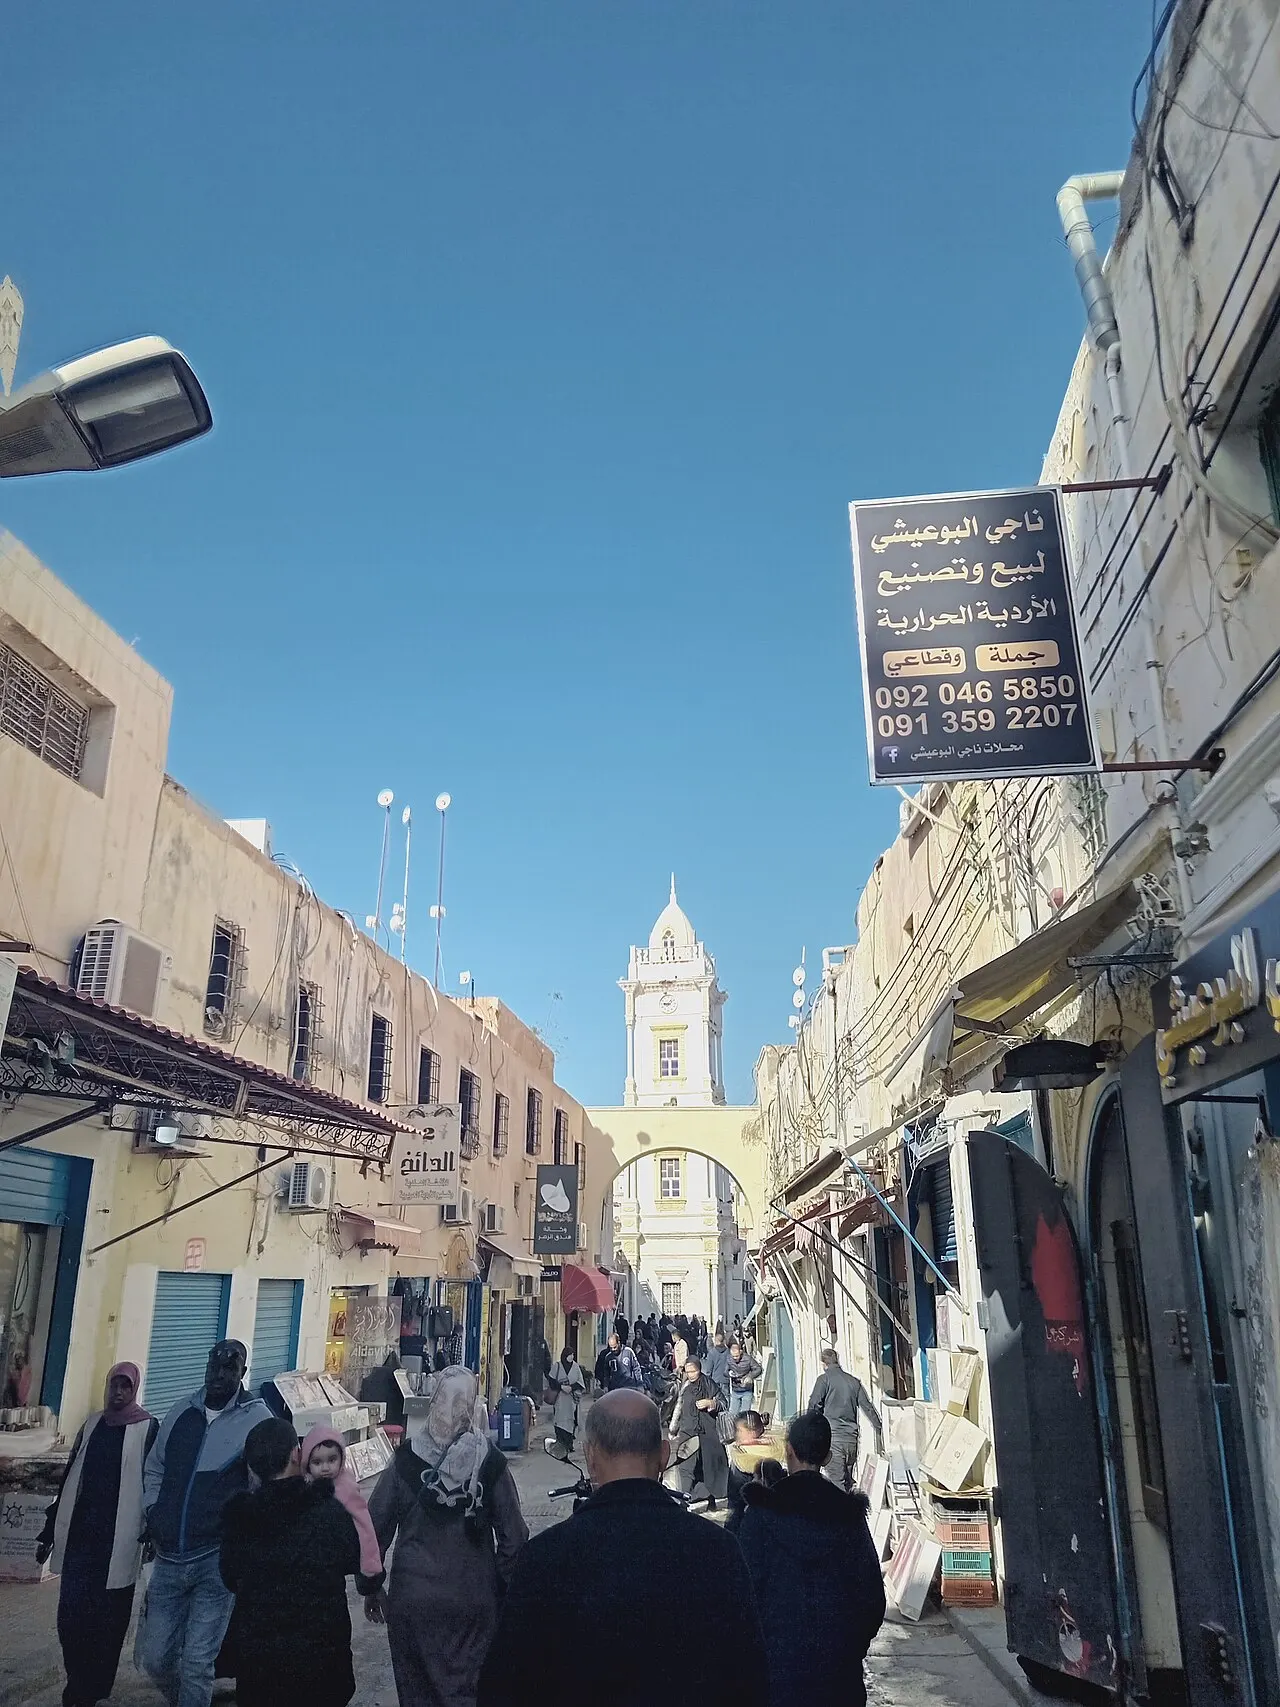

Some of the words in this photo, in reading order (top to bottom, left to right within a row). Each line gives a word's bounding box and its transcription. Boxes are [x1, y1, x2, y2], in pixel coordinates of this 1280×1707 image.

[870, 515, 979, 554] البوعيشي
[985, 508, 1044, 544] ناجي
[877, 557, 984, 597] وتصنيع
[990, 550, 1045, 588] لبيع
[876, 604, 974, 636] الحرارية
[975, 595, 1057, 628] الأردية
[887, 648, 961, 677] وقطاعي
[989, 646, 1045, 666] جملة
[875, 684, 929, 709] 092
[938, 680, 993, 706] 046
[1003, 674, 1075, 701] 5850
[878, 712, 929, 738] 091
[941, 709, 996, 734] 359
[1005, 703, 1078, 730] 2207
[910, 744, 955, 761] البوعيشي
[957, 743, 982, 759] ناجي
[983, 741, 1024, 754] محلات
[423, 1127, 435, 1140] 2
